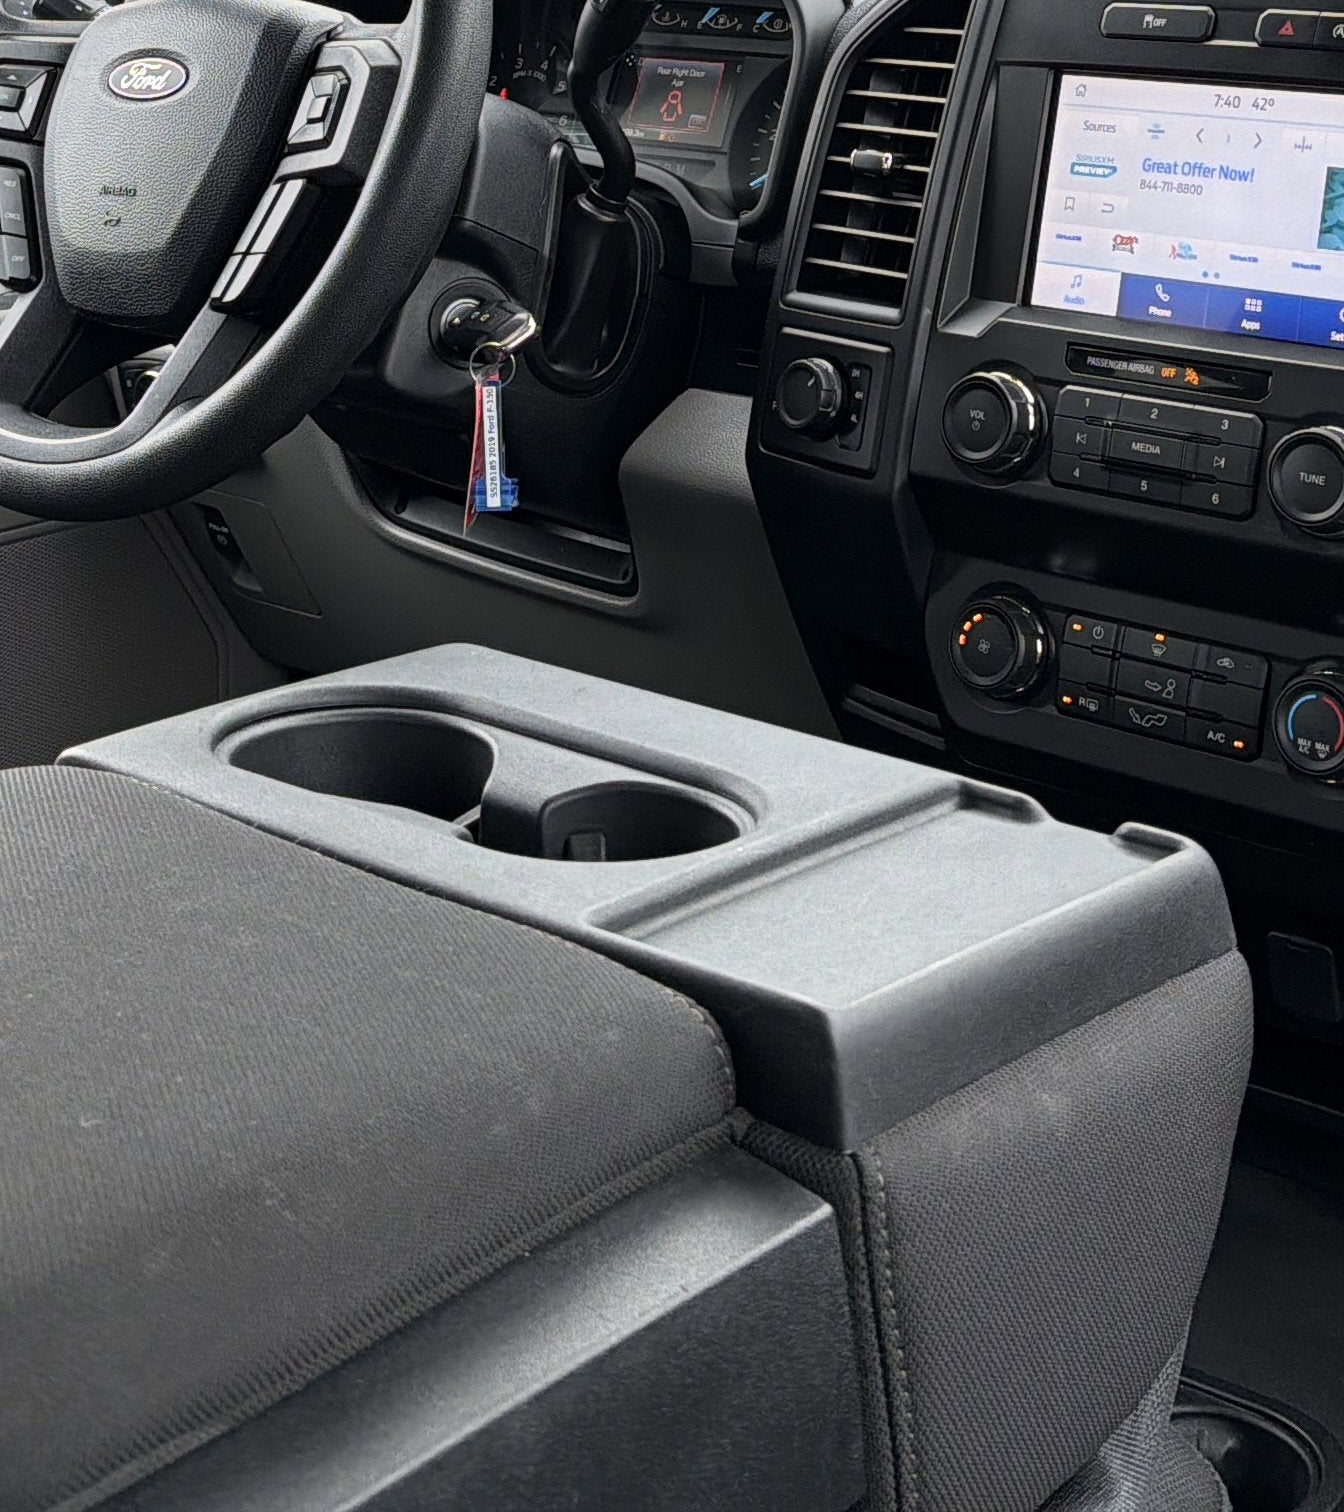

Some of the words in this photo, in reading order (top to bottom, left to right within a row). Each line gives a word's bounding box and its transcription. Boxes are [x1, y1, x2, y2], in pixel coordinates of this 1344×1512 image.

[1152, 17, 1167, 27] OFF
[120, 62, 172, 91] Ford
[1213, 93, 1242, 110] 7:40
[1082, 119, 1117, 134] Sources
[1073, 165, 1113, 177] PREVIEW
[1142, 157, 1178, 174] Great
[1180, 160, 1217, 179] Offer
[1218, 164, 1255, 184] Now!
[1063, 294, 1086, 306] Audio
[1148, 305, 1173, 319] Phone
[1240, 317, 1261, 331] Apps
[1086, 355, 1129, 371] PASSENGER
[1127, 360, 1155, 376] AIRBAG
[1160, 366, 1178, 379] OFF
[485, 388, 494, 413] F-150
[1084, 397, 1091, 409] 1
[969, 408, 986, 421] VOL
[1150, 408, 1159, 420] 2
[487, 414, 496, 434] Ford
[1220, 419, 1230, 431] 3
[488, 436, 497, 458] 2019
[1131, 441, 1161, 456] MEDIA
[1072, 467, 1081, 479] 4
[1298, 471, 1327, 486] TUNE
[1140, 479, 1149, 492] 5
[1211, 492, 1220, 505] 6
[1207, 729, 1227, 744] A/C
[1297, 737, 1312, 746] MAX
[1315, 741, 1330, 753] MAX
